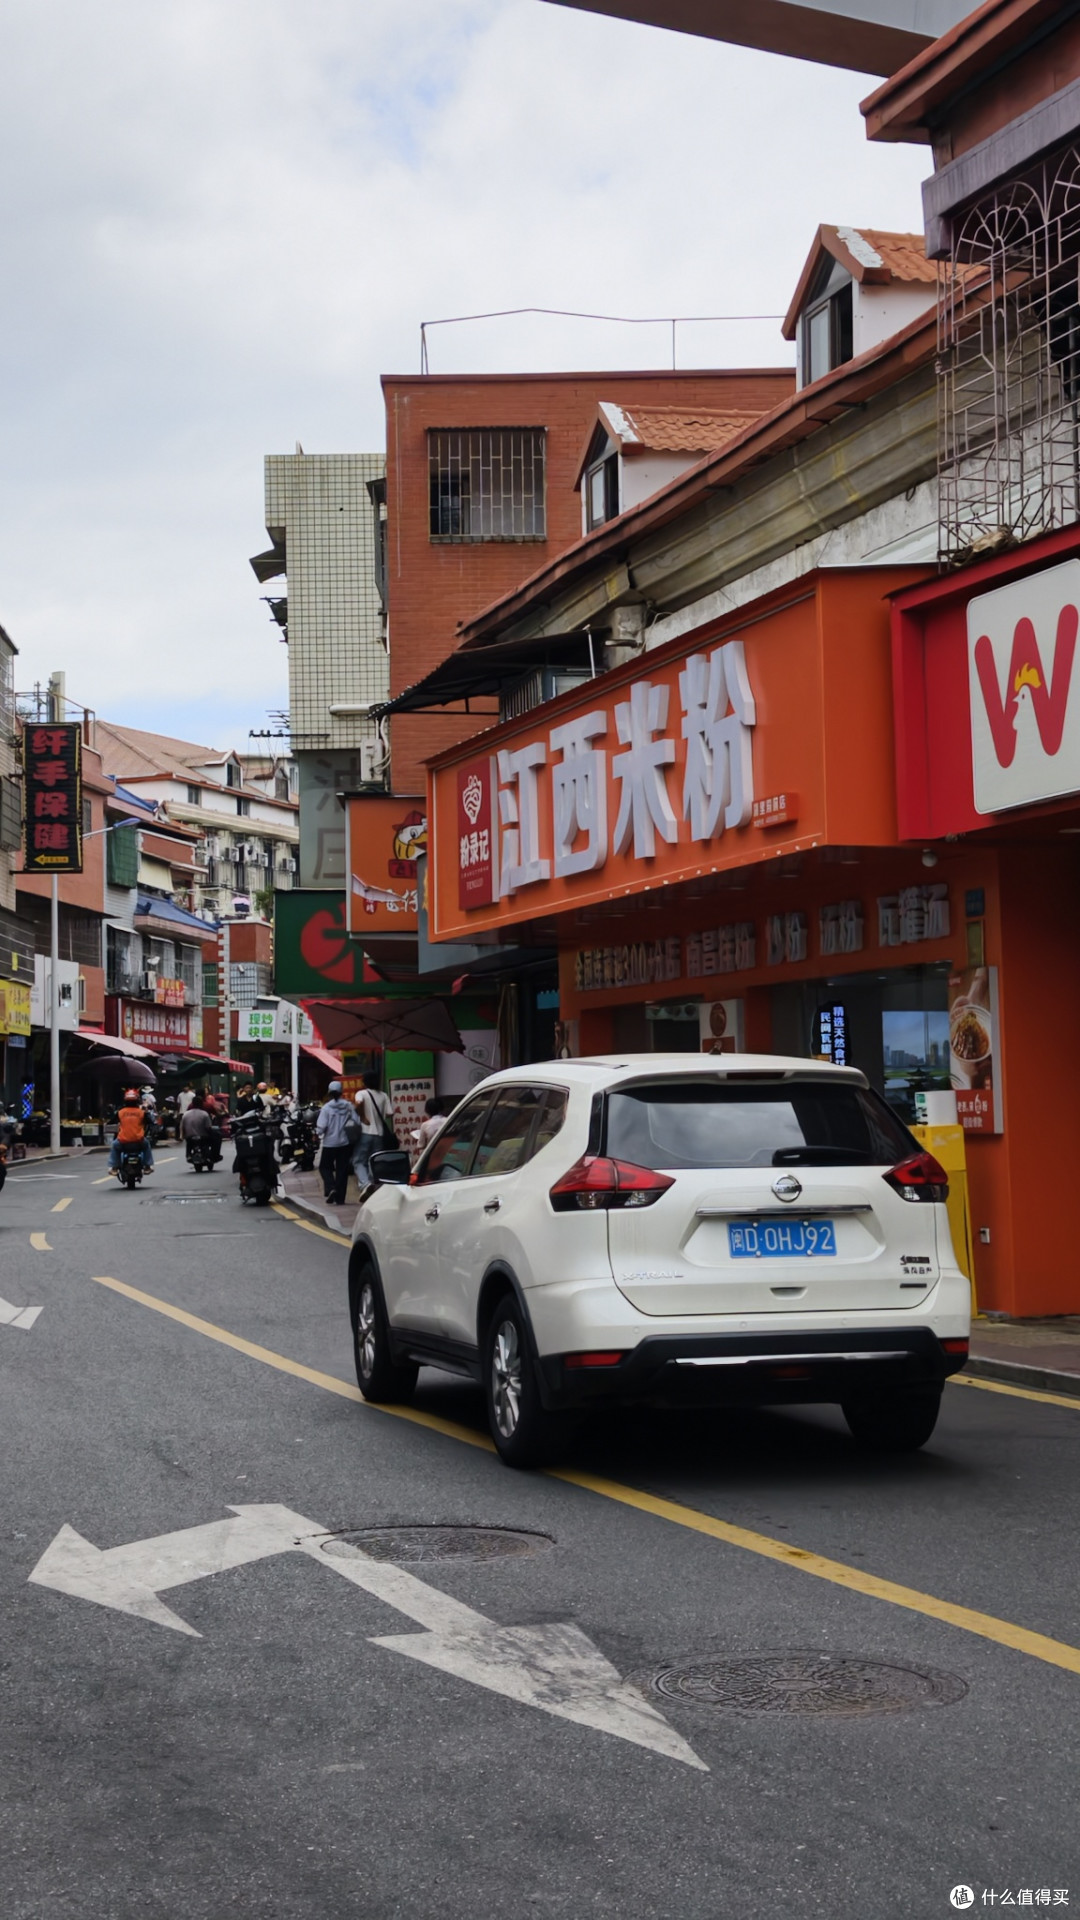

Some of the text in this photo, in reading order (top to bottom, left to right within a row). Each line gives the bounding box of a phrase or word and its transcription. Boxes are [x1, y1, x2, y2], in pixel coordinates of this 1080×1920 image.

[975, 604, 1078, 768] W
[32, 728, 70, 849] 纤手保健
[497, 640, 756, 898] 江西米粉
[877, 883, 949, 948] 瓦罐汤
[248, 1026, 273, 1038] 快餐
[249, 1013, 273, 1025] 现炒
[820, 1012, 833, 1062] 民间瓦罐
